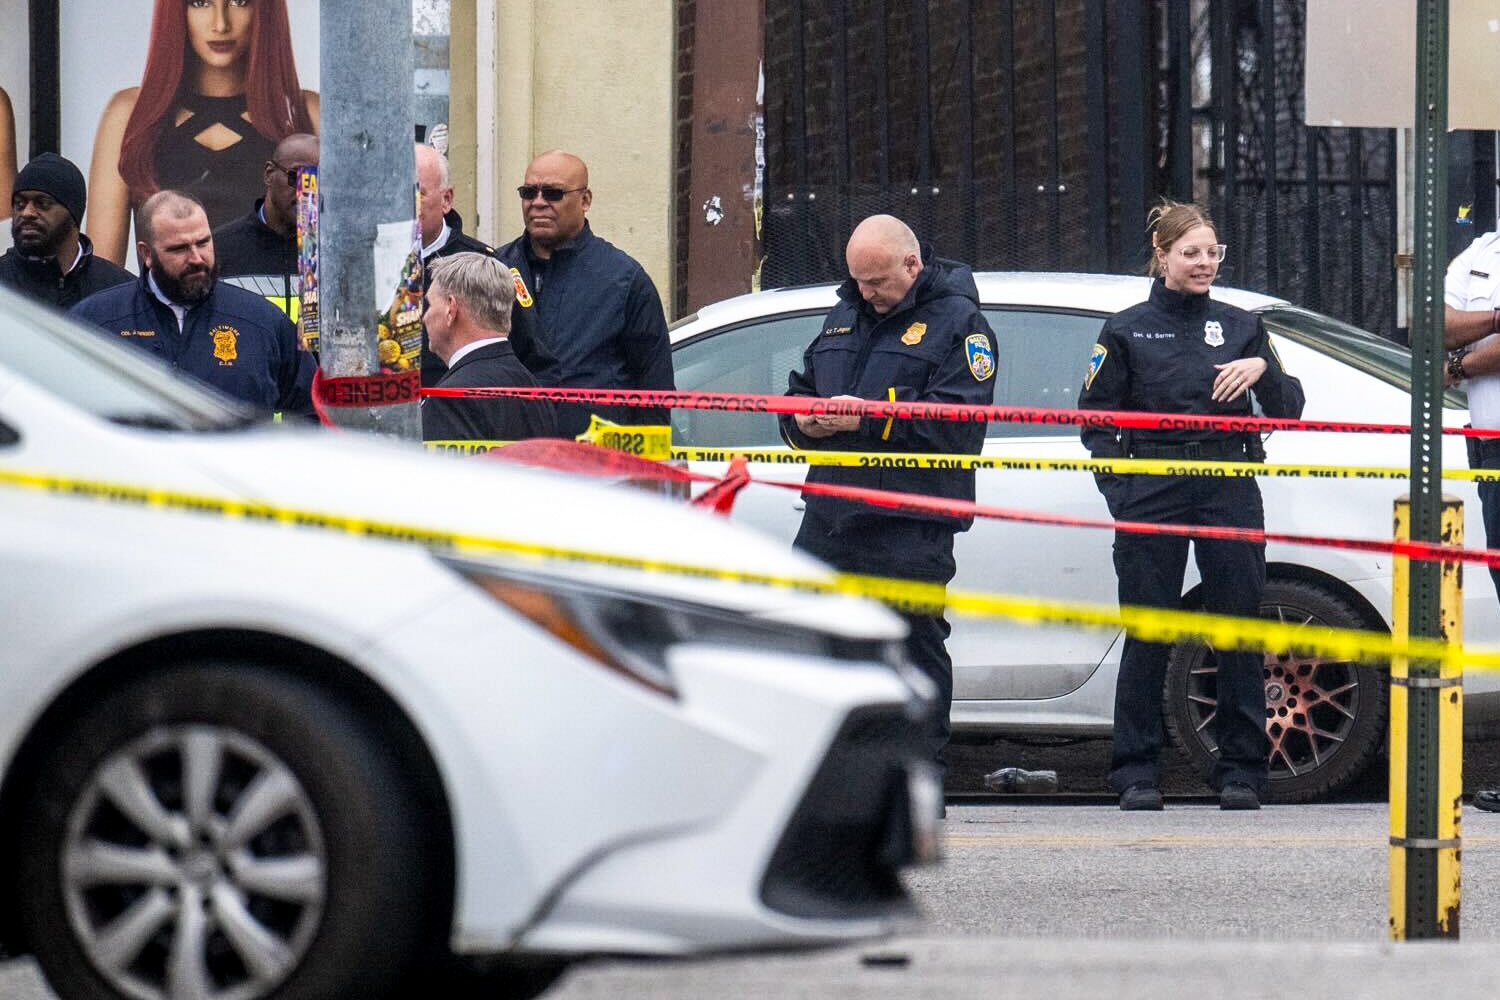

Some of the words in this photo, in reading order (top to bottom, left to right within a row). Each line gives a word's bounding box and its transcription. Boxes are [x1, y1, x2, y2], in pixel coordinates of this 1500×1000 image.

[695, 396, 769, 412] CROSS
[810, 400, 877, 418] CRIME
[882, 403, 952, 420] SCENE
